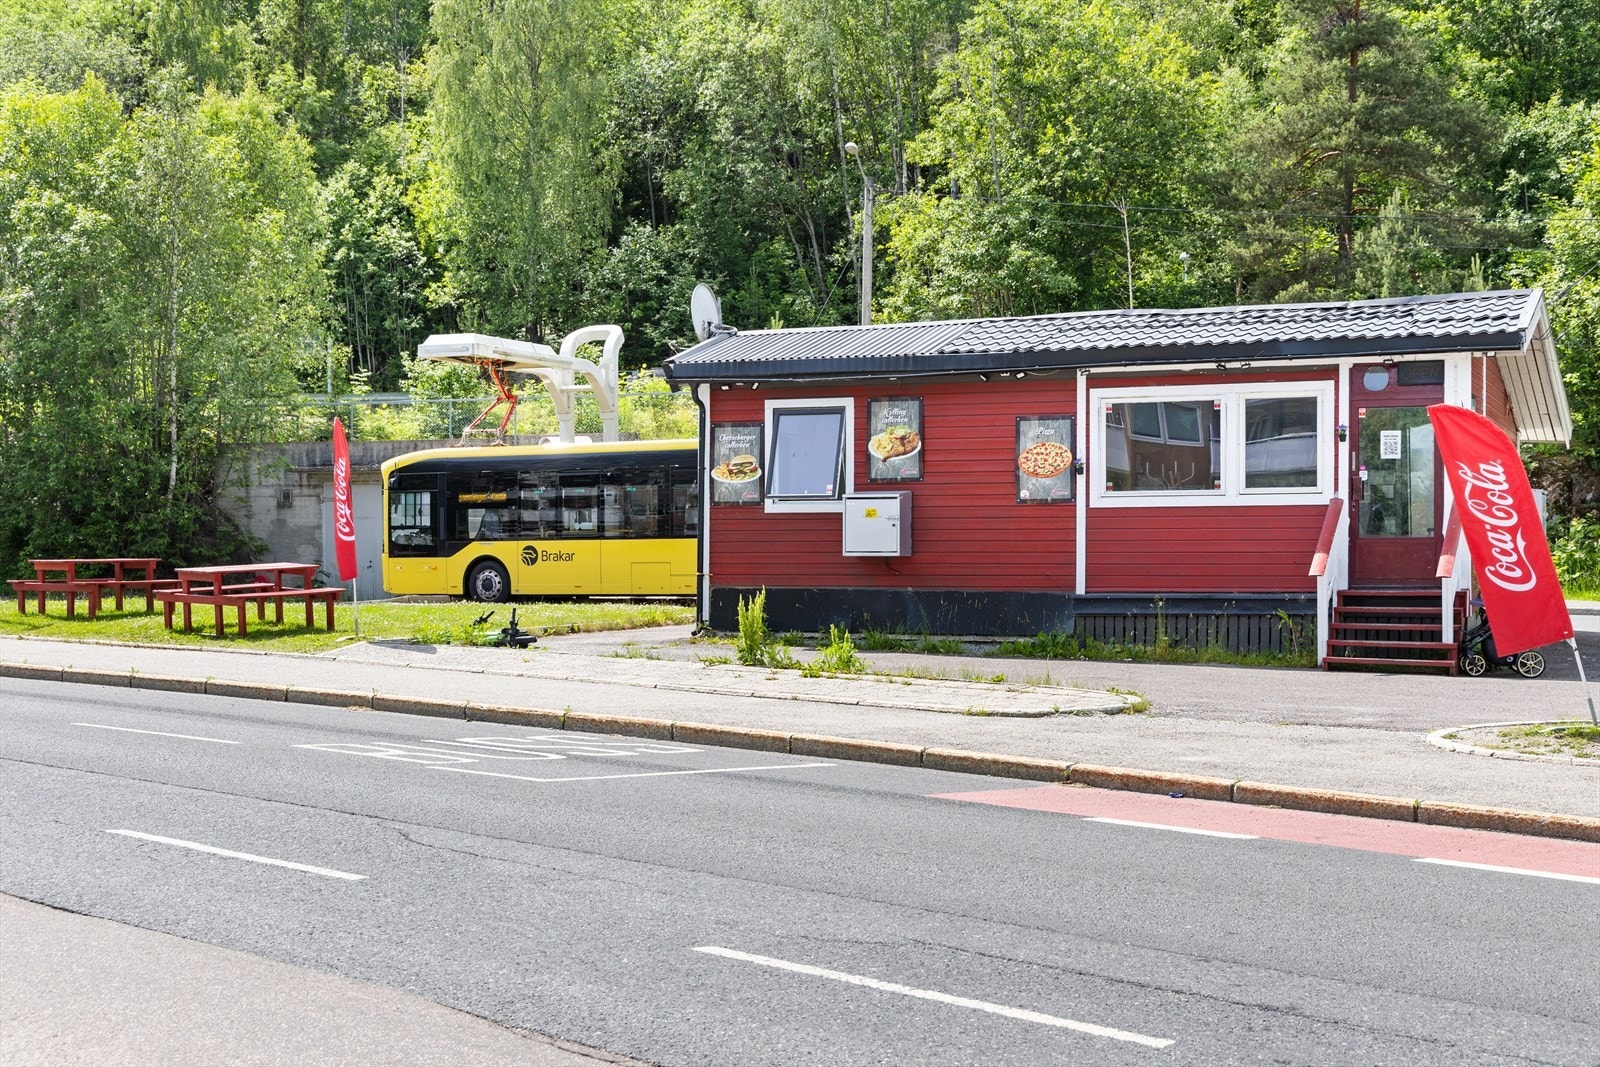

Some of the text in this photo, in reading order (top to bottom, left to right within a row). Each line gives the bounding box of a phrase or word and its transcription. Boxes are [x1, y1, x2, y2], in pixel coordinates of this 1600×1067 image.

[1402, 367, 1440, 380] OPEN
[883, 407, 907, 418] Kylling
[719, 434, 756, 443] Cheeseburger
[1456, 459, 1537, 592] Coca-Cola
[541, 550, 575, 562] Brakar
